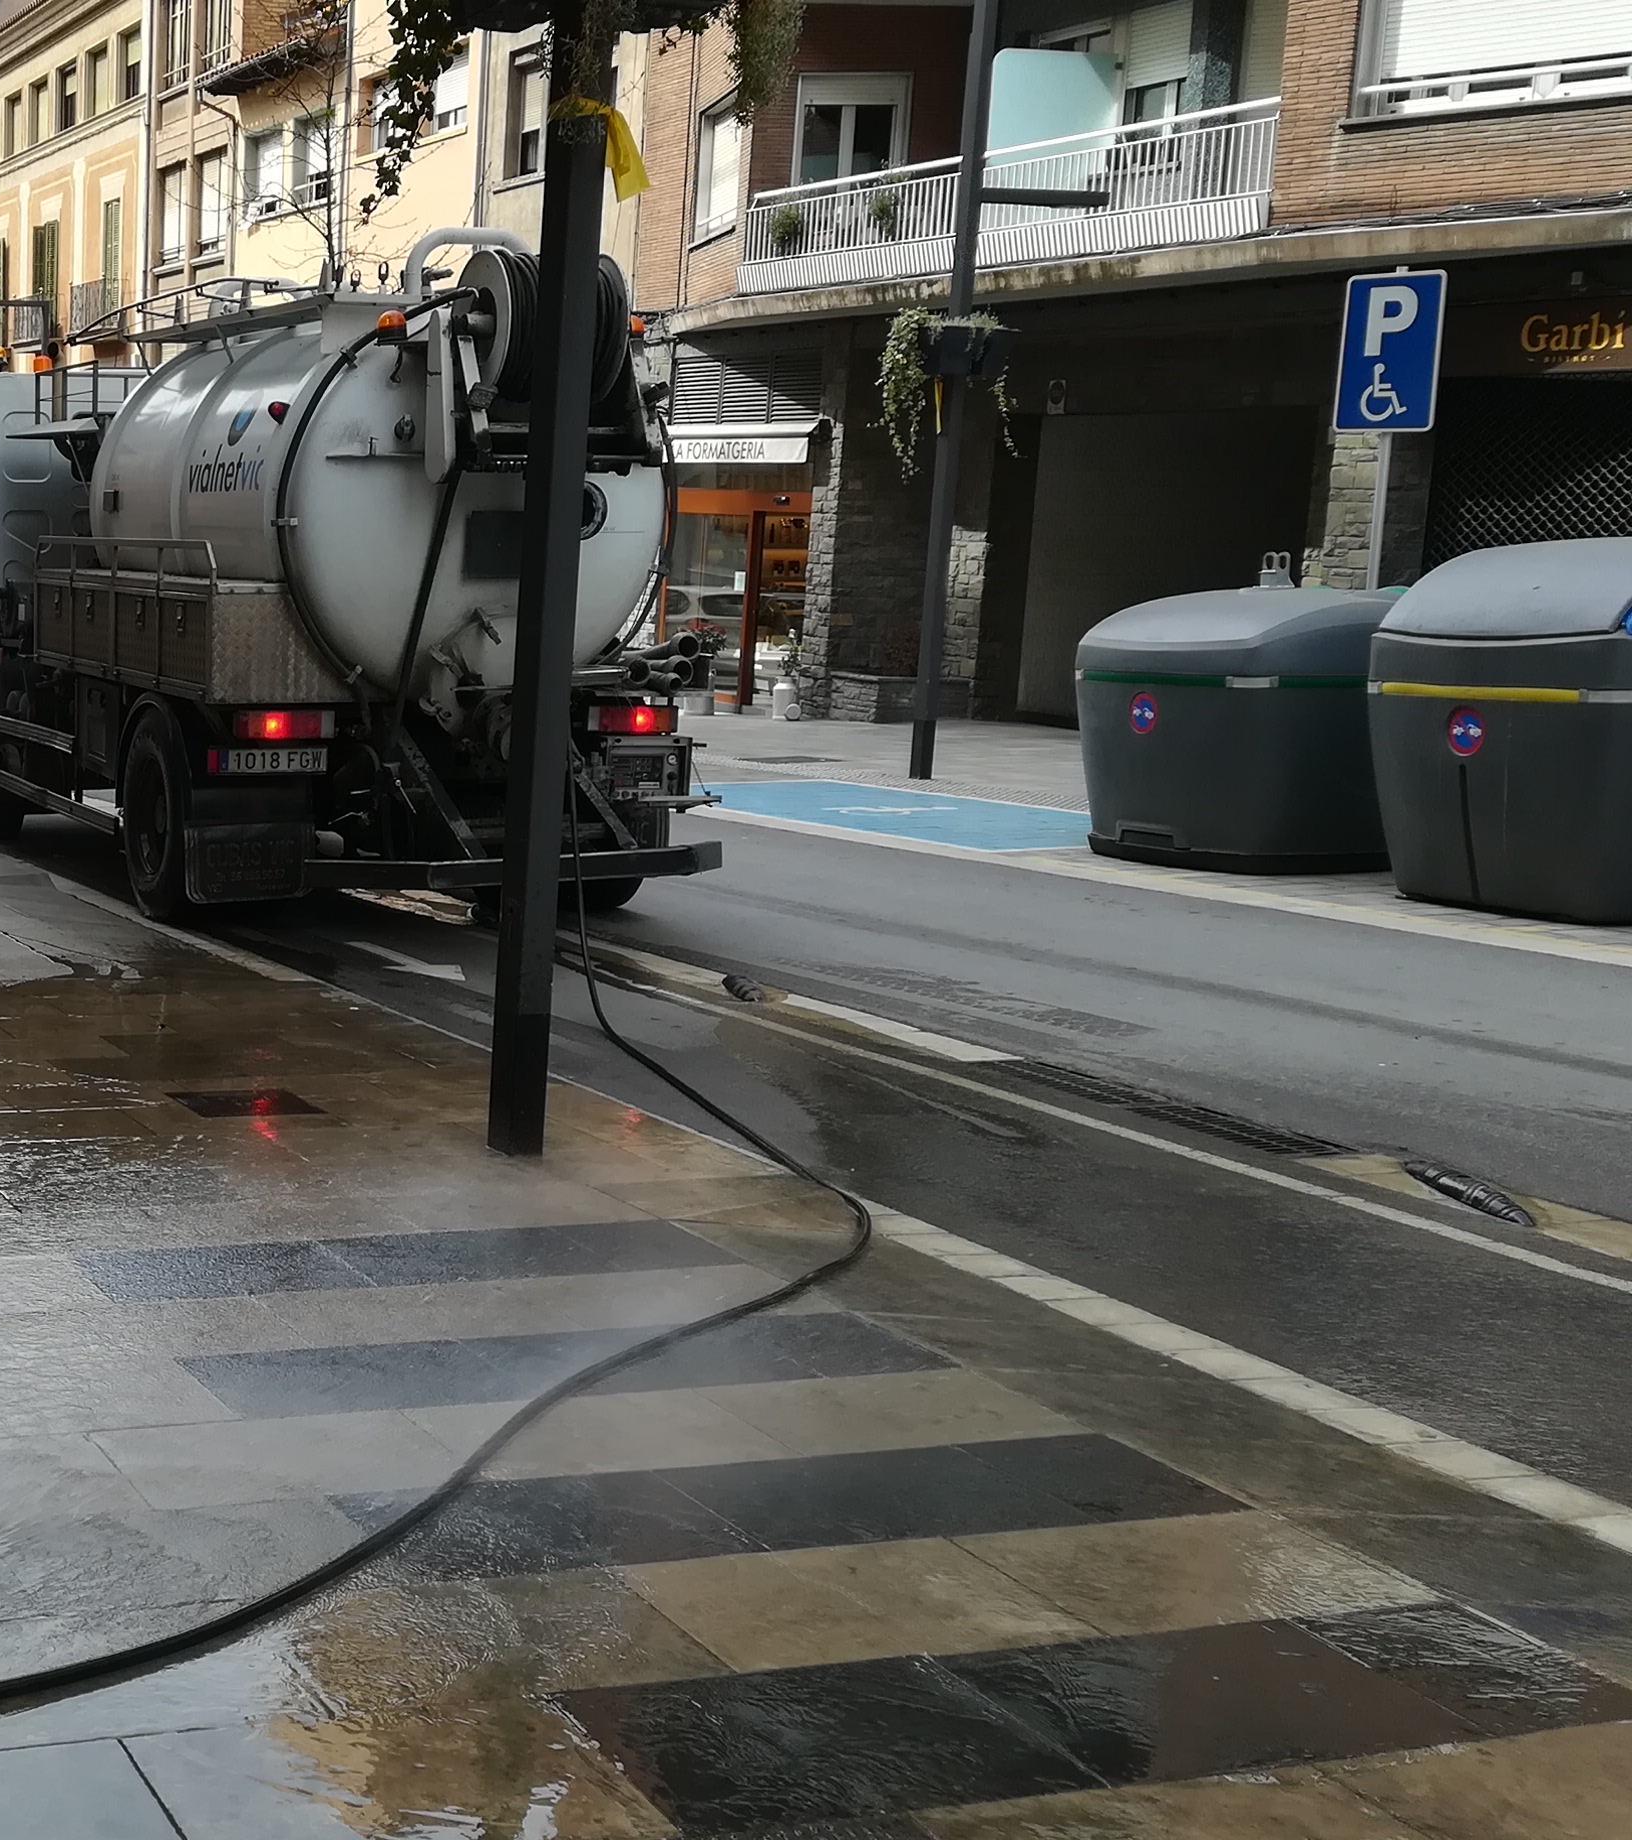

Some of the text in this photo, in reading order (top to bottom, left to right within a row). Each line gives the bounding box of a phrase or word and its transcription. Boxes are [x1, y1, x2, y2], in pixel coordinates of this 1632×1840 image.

[1364, 285, 1418, 357] P
[1521, 310, 1626, 352] Garbí
[189, 443, 264, 493] vialnetvic
[686, 441, 766, 460] FORMATGERIA
[235, 751, 322, 769] 1018 FGW
